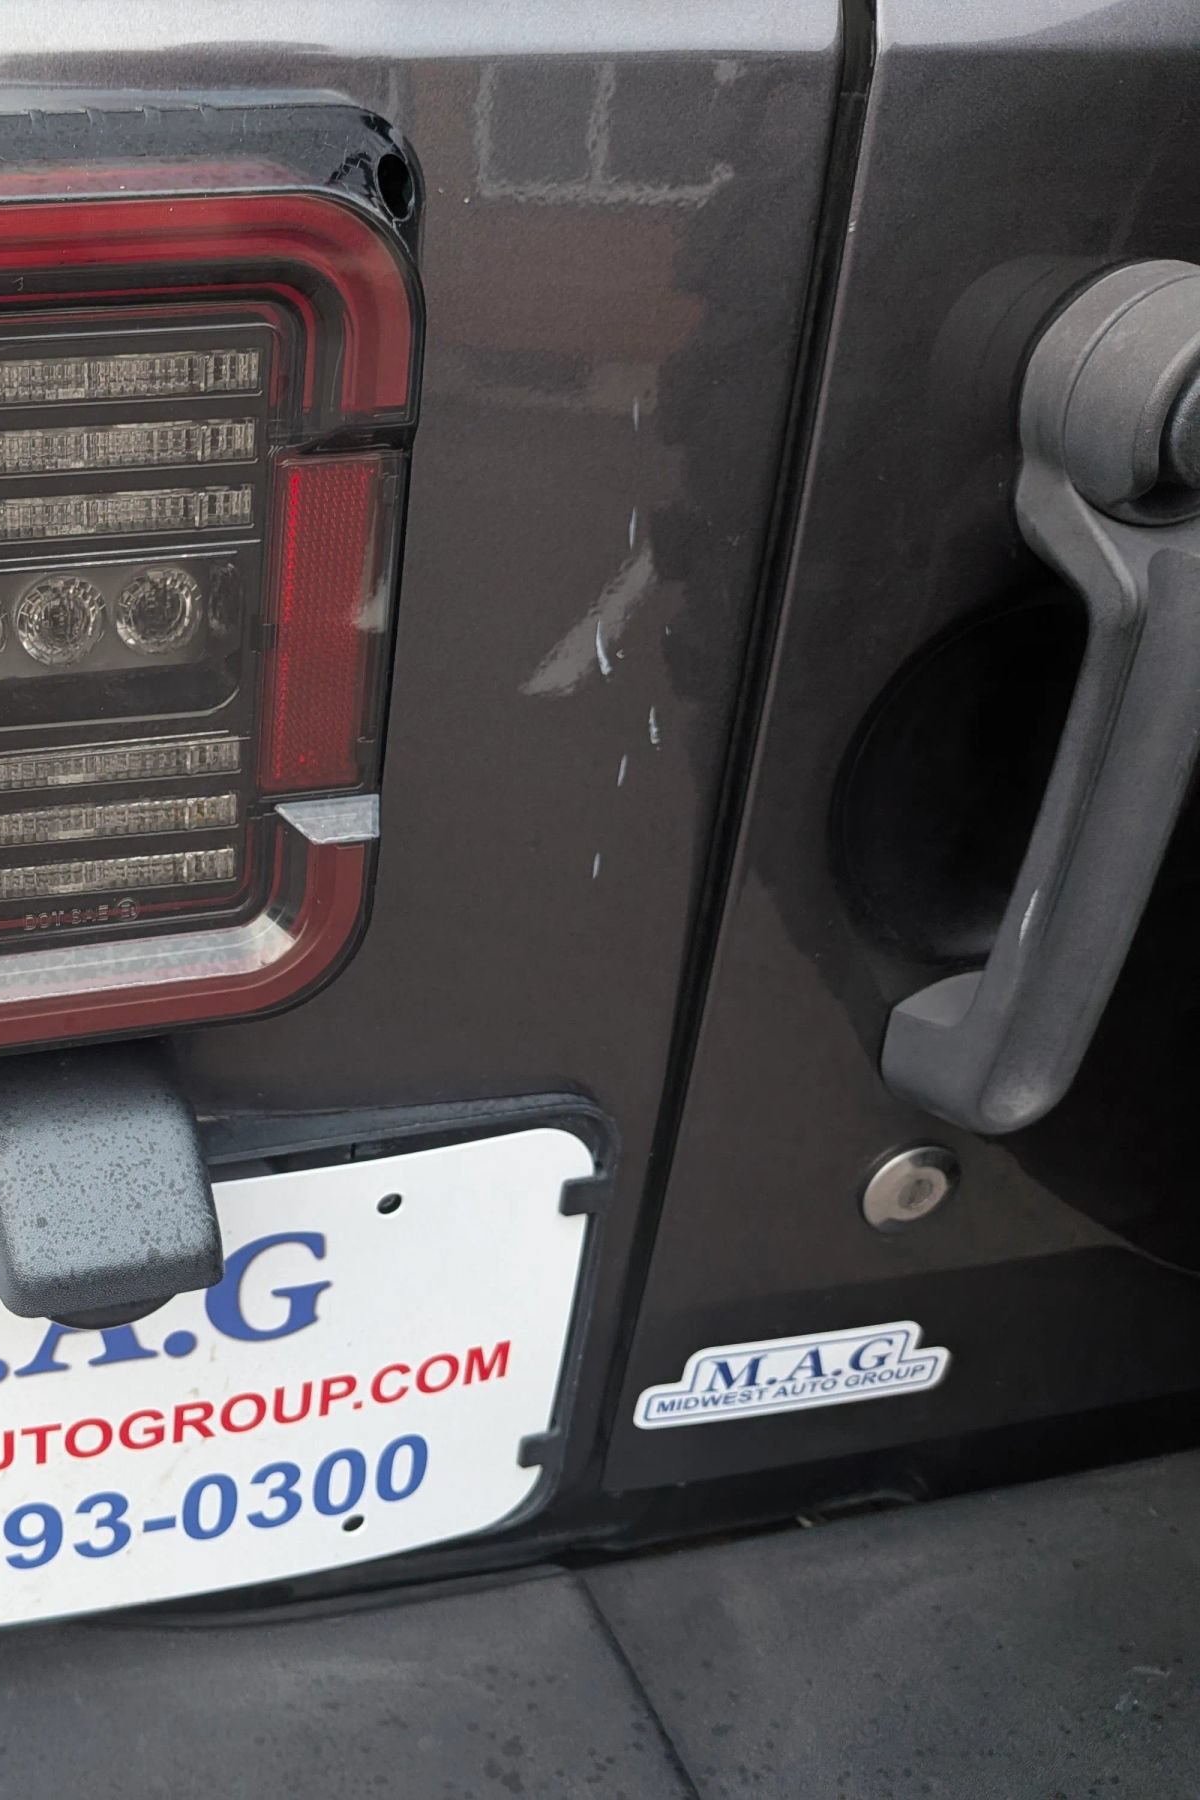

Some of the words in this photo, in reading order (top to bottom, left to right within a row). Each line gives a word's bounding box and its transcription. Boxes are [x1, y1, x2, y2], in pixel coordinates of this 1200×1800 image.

[656, 1387, 768, 1413] MIDWEST
[773, 1376, 837, 1399] AUTO
[844, 1364, 926, 1388] GROUP
[702, 1338, 894, 1392] M.A.G
